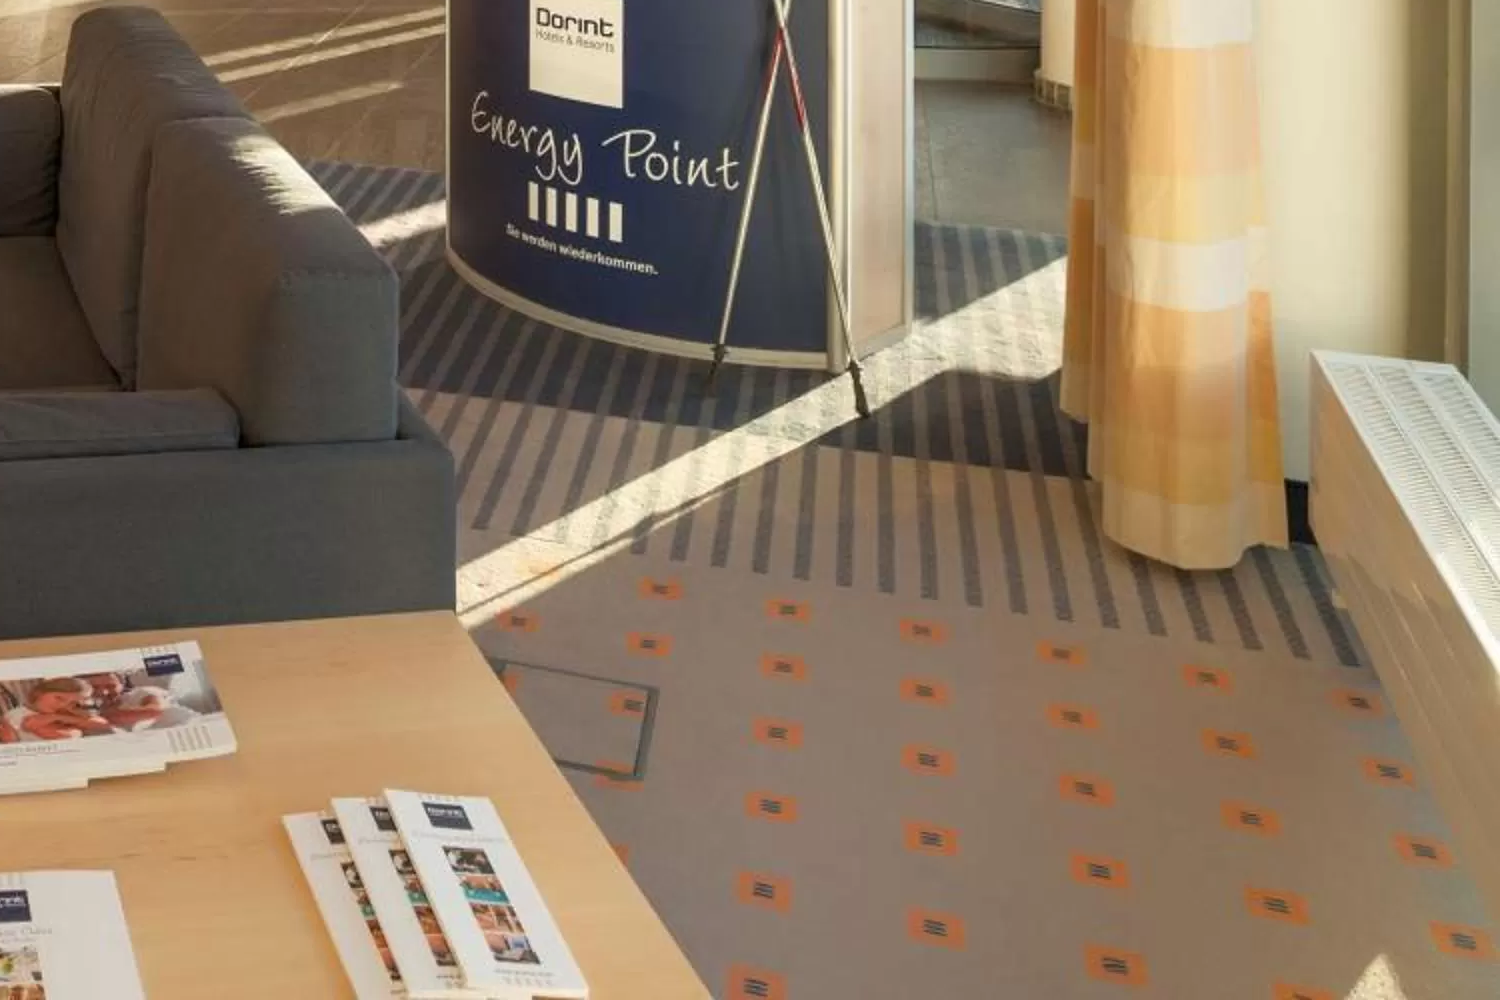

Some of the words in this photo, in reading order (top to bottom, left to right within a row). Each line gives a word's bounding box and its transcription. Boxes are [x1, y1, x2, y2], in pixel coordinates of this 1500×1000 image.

[536, 6, 614, 38] Dorint
[535, 27, 564, 44] Hotels
[576, 34, 615, 54] Resorts
[471, 90, 583, 186] Energy
[601, 128, 739, 191] Point
